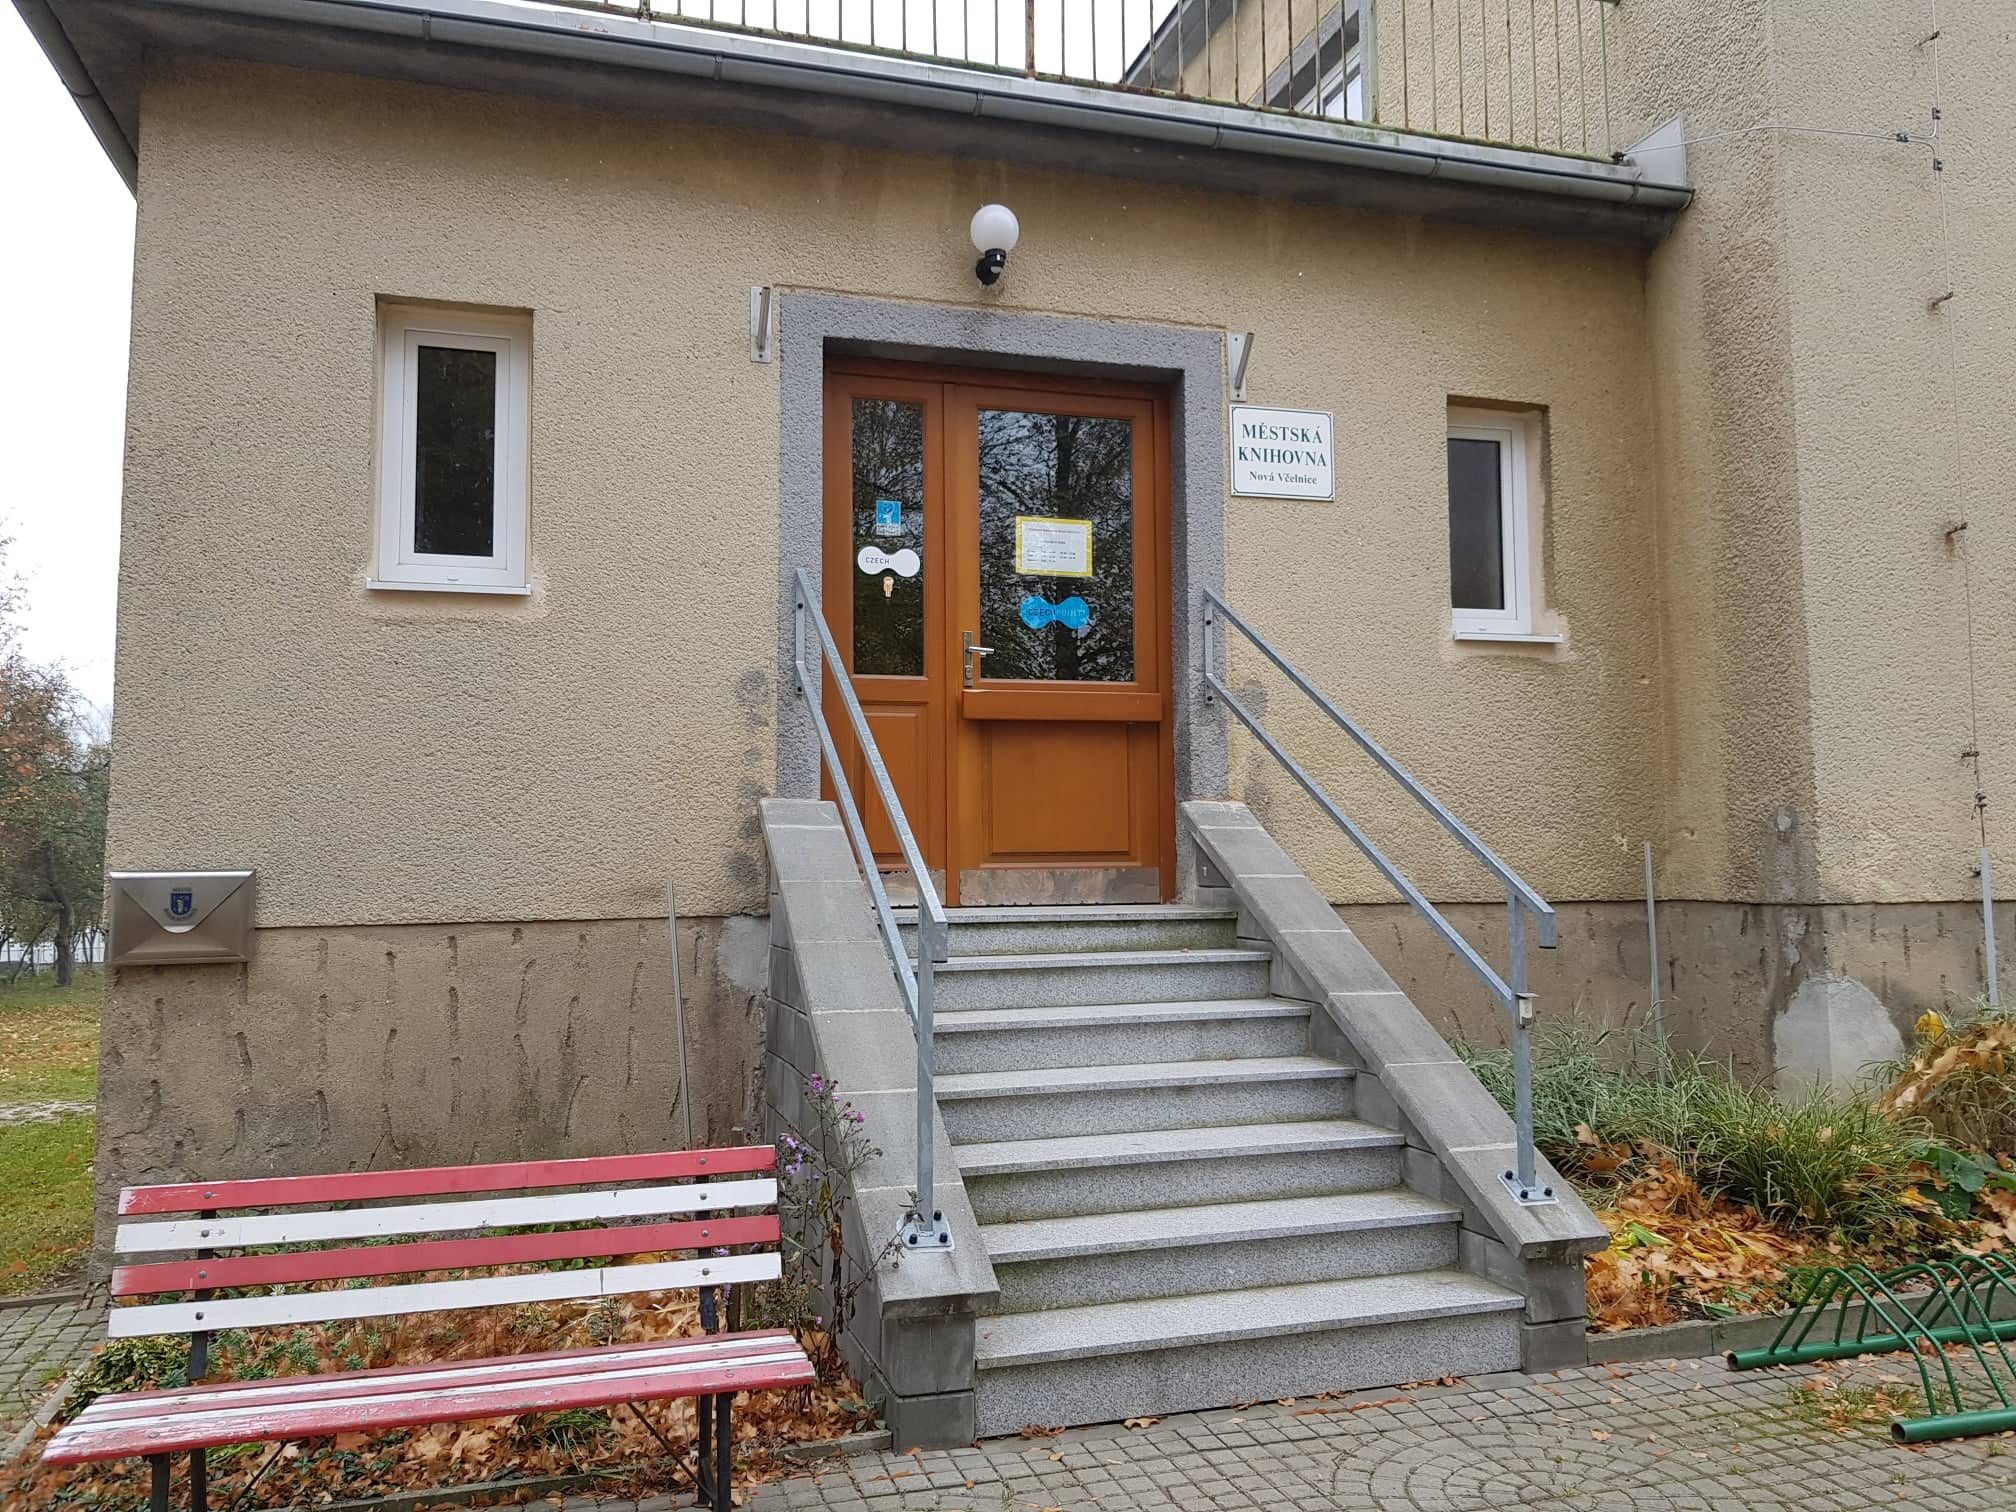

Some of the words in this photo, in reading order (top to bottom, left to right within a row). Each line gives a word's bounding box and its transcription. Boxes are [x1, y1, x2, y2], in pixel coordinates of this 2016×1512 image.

[1242, 422, 1322, 444] MĚSTSKÁ
[1238, 446, 1327, 467] KNIHOVNA
[1249, 471, 1275, 482] Nová
[1277, 472, 1318, 485] Včelnice
[865, 557, 890, 565] CZECH
